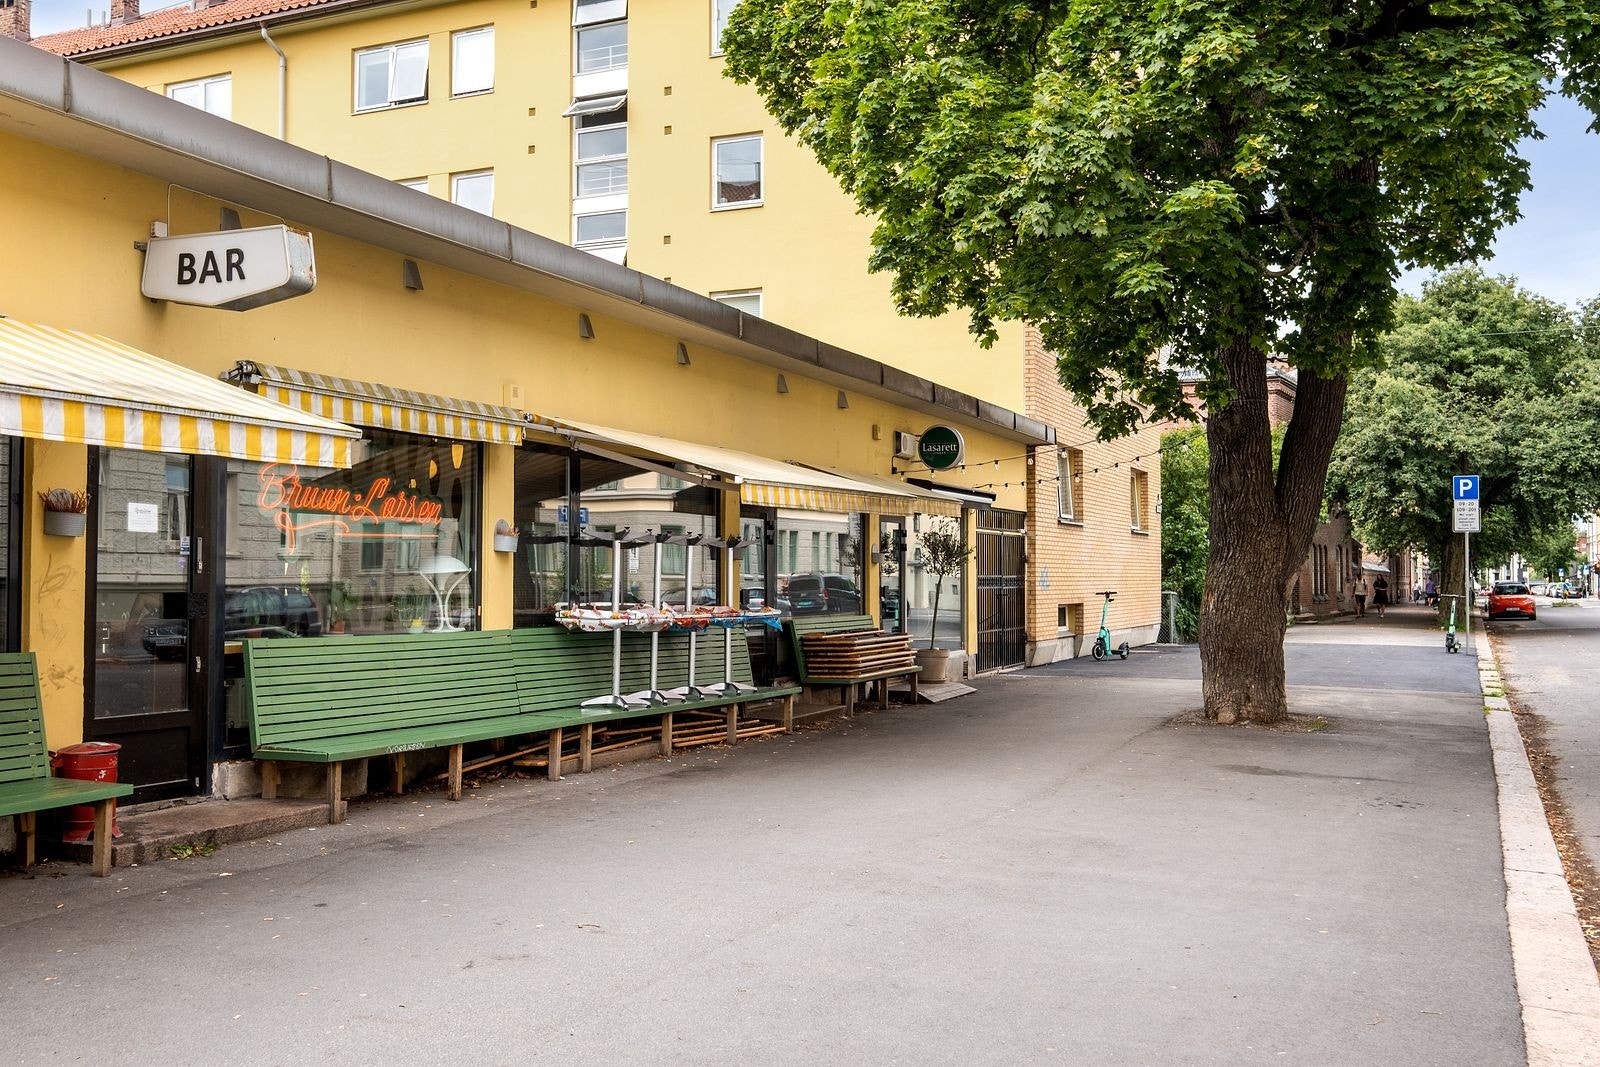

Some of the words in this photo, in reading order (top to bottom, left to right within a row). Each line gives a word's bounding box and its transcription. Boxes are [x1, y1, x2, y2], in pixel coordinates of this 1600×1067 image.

[177, 248, 246, 285] BAR
[922, 443, 957, 452] Lasarett
[1460, 479, 1472, 497] P
